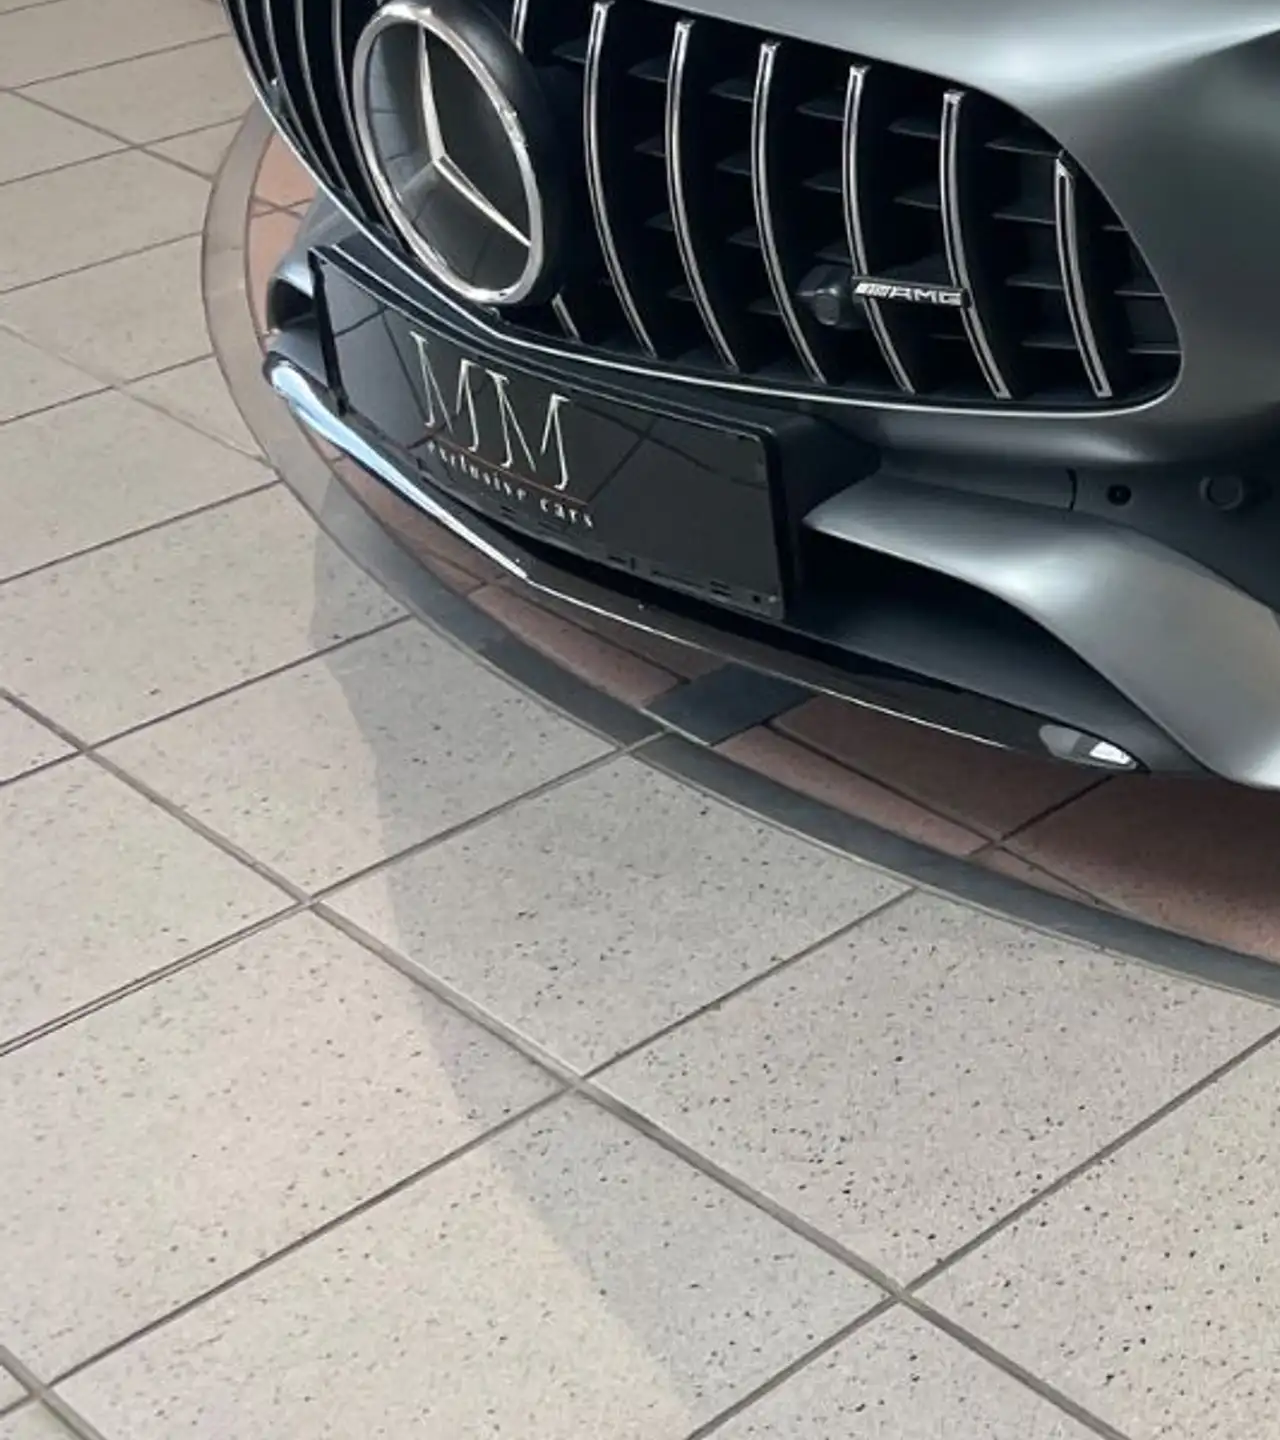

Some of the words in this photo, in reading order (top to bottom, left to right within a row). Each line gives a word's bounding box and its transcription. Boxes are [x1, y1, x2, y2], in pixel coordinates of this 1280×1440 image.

[884, 285, 961, 306] AMG
[409, 330, 571, 491] MM
[427, 438, 527, 501] exclusive
[539, 497, 594, 529] cars
